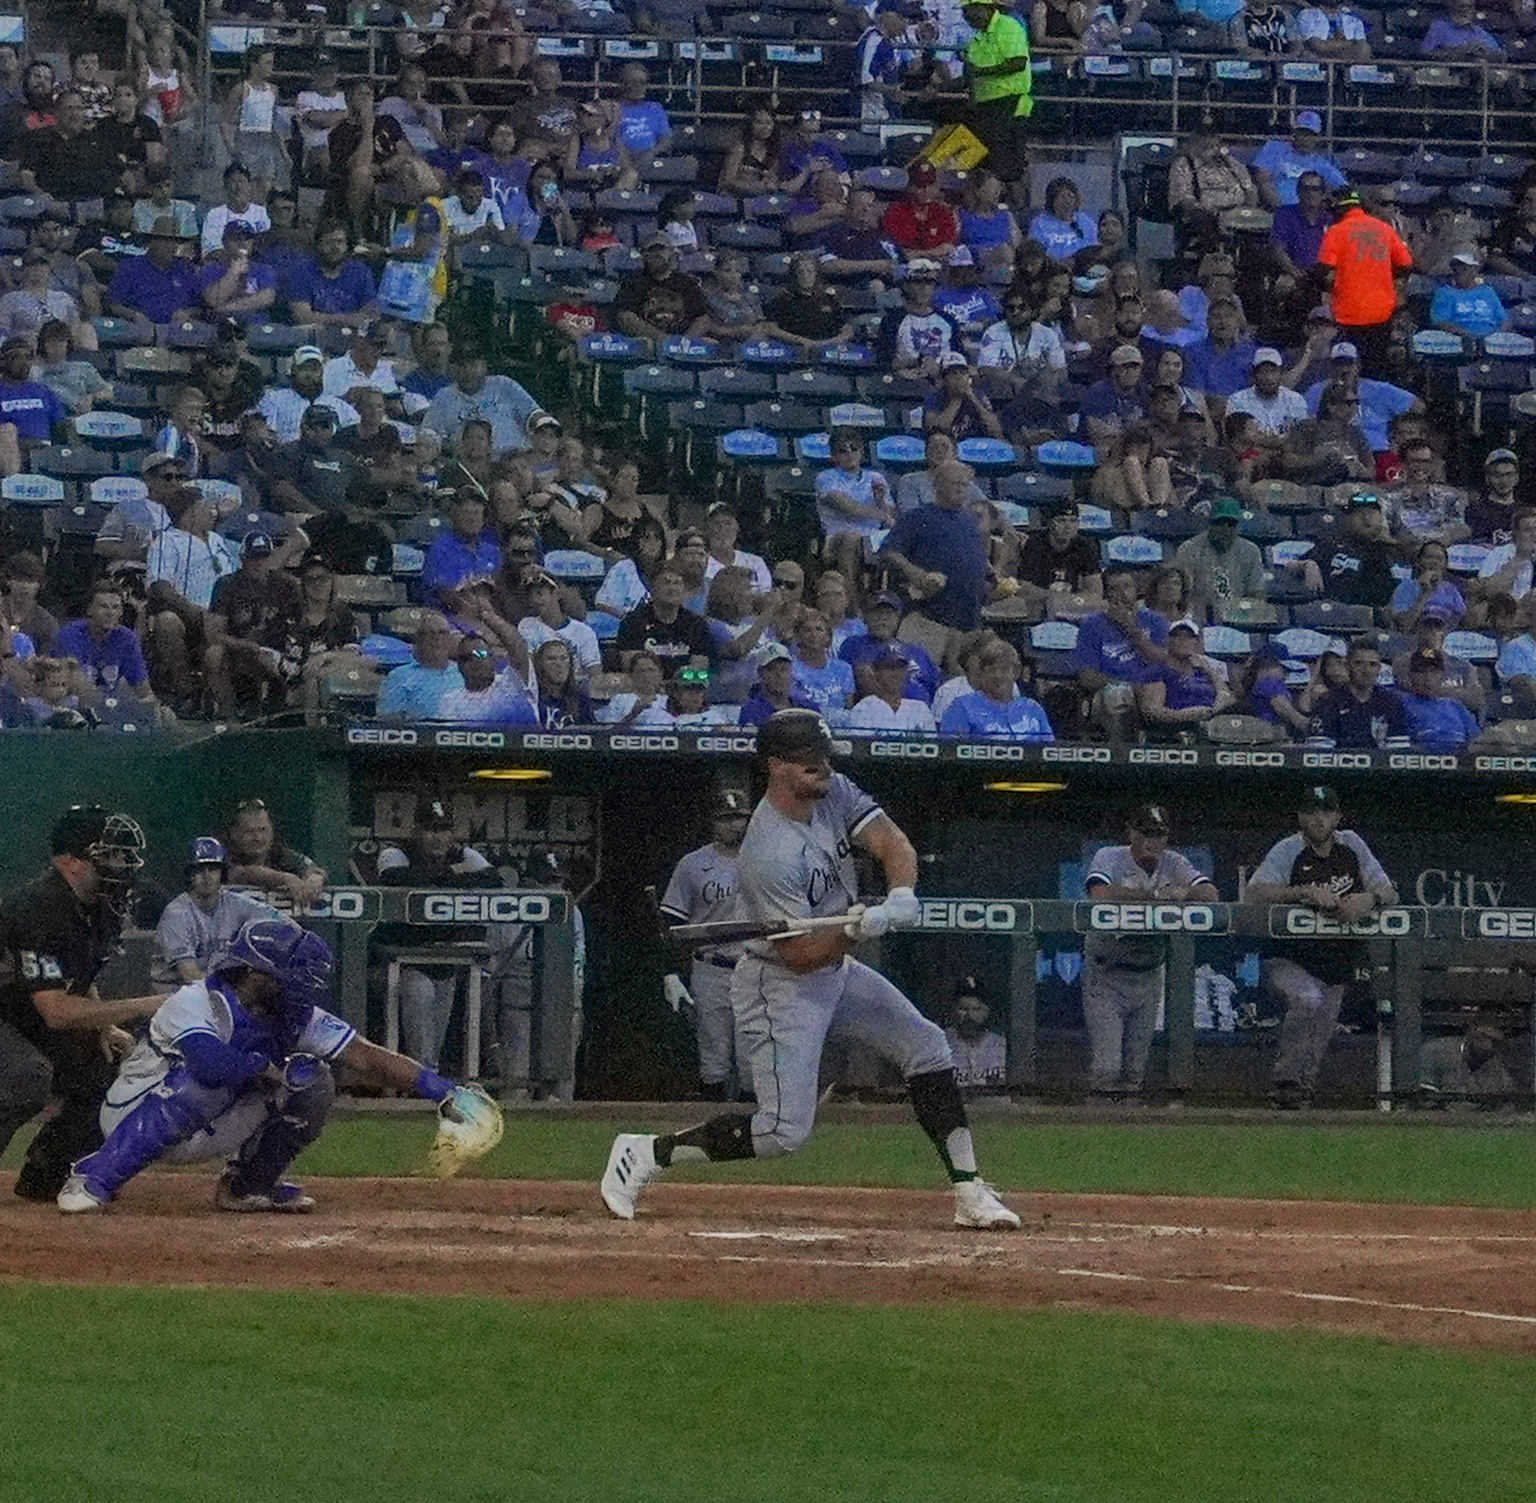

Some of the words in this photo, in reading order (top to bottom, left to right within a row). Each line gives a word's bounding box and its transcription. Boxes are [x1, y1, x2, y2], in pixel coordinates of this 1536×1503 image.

[488, 175, 520, 206] KC
[1350, 230, 1387, 263] 75
[349, 729, 417, 745] GEICO
[436, 732, 504, 747] GEICO
[522, 733, 591, 750] GEICO
[610, 735, 678, 752] GEICO
[871, 740, 939, 758] GEICO
[957, 743, 1024, 760] GEICO
[1042, 746, 1111, 763] GEICO
[1129, 748, 1198, 764] GEICO
[1216, 750, 1285, 766] GEICO
[1303, 752, 1371, 768] GEICO
[1390, 754, 1458, 770] GEICO
[424, 895, 549, 922] GEICO
[913, 902, 1015, 929] EICO
[1091, 905, 1214, 931] GEICO
